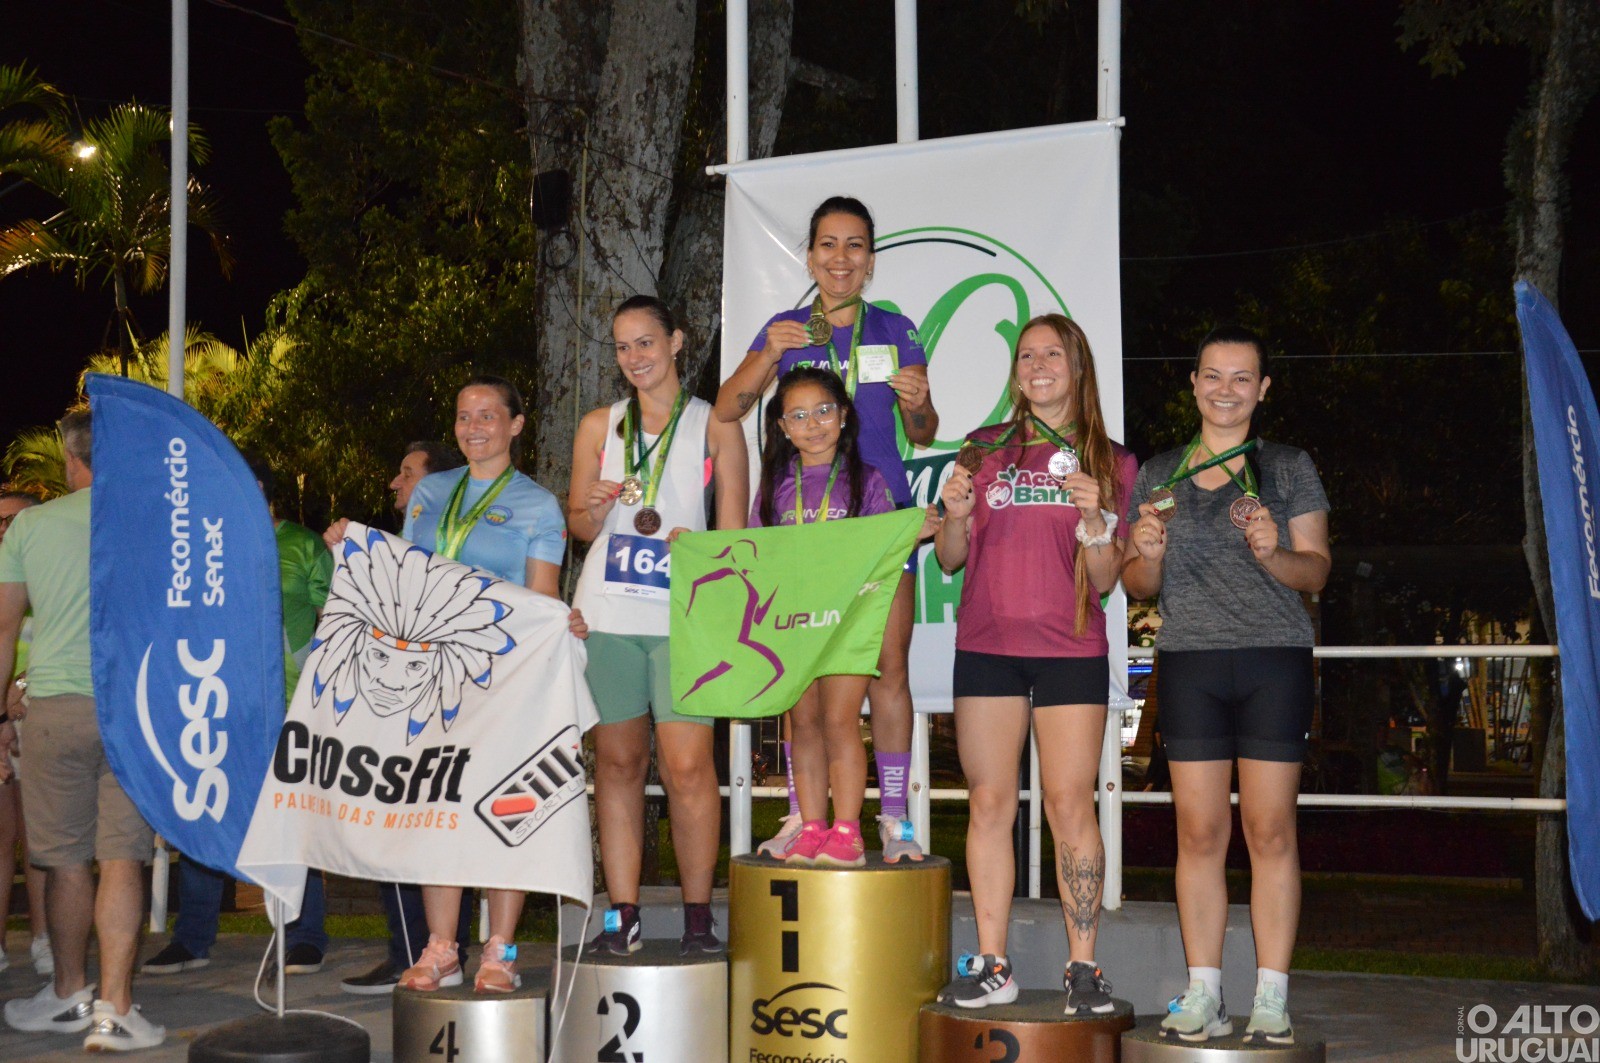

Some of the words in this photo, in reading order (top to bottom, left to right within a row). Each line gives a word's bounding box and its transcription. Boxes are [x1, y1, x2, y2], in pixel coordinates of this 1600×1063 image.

[164, 437, 192, 607] Fecomércio
[202, 517, 225, 607] Senac
[615, 546, 671, 578] 164
[273, 720, 471, 804] CrossFit
[883, 765, 905, 797] RUN
[273, 792, 332, 816] PALMEIRA
[338, 803, 376, 826] DAS
[383, 808, 461, 830] MISSÕES
[515, 789, 563, 839] SPORT
[429, 1021, 460, 1063] 4
[597, 991, 644, 1063] 2
